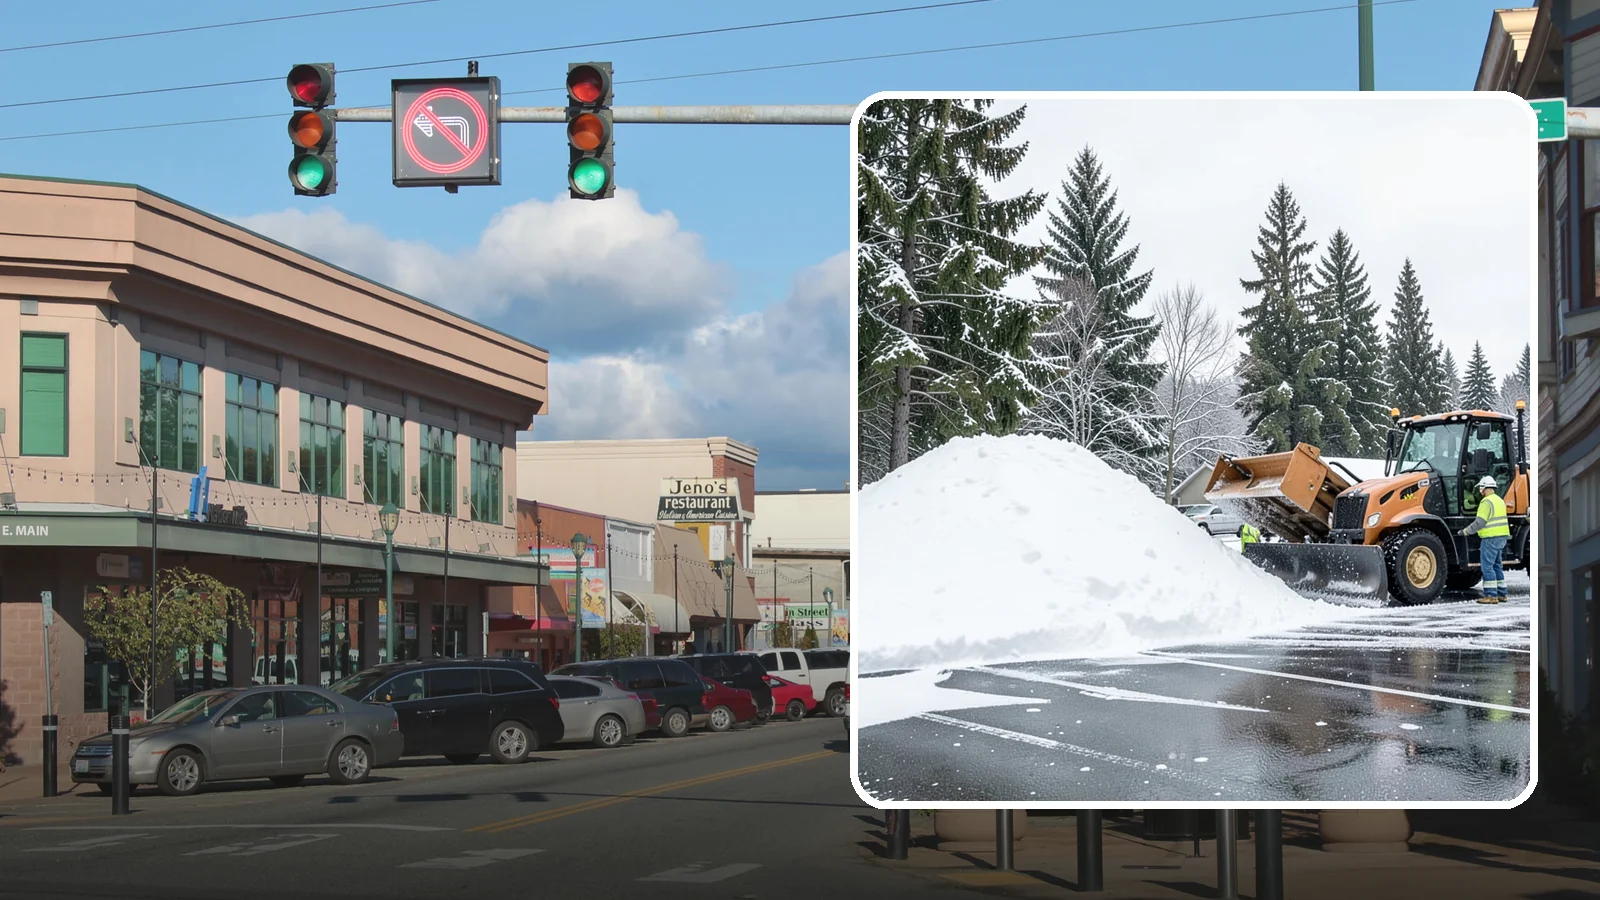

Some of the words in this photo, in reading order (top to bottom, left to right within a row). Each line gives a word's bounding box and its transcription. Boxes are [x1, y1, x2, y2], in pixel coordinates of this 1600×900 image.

[669, 480, 727, 494] Jeno's
[665, 496, 731, 509] restaurant
[658, 510, 682, 519] Italian
[686, 510, 714, 519] American
[715, 510, 737, 519] Cuisine
[2, 525, 13, 536] E.
[15, 525, 49, 536] MAIN
[797, 608, 829, 617] Street
[790, 619, 824, 627] lass
